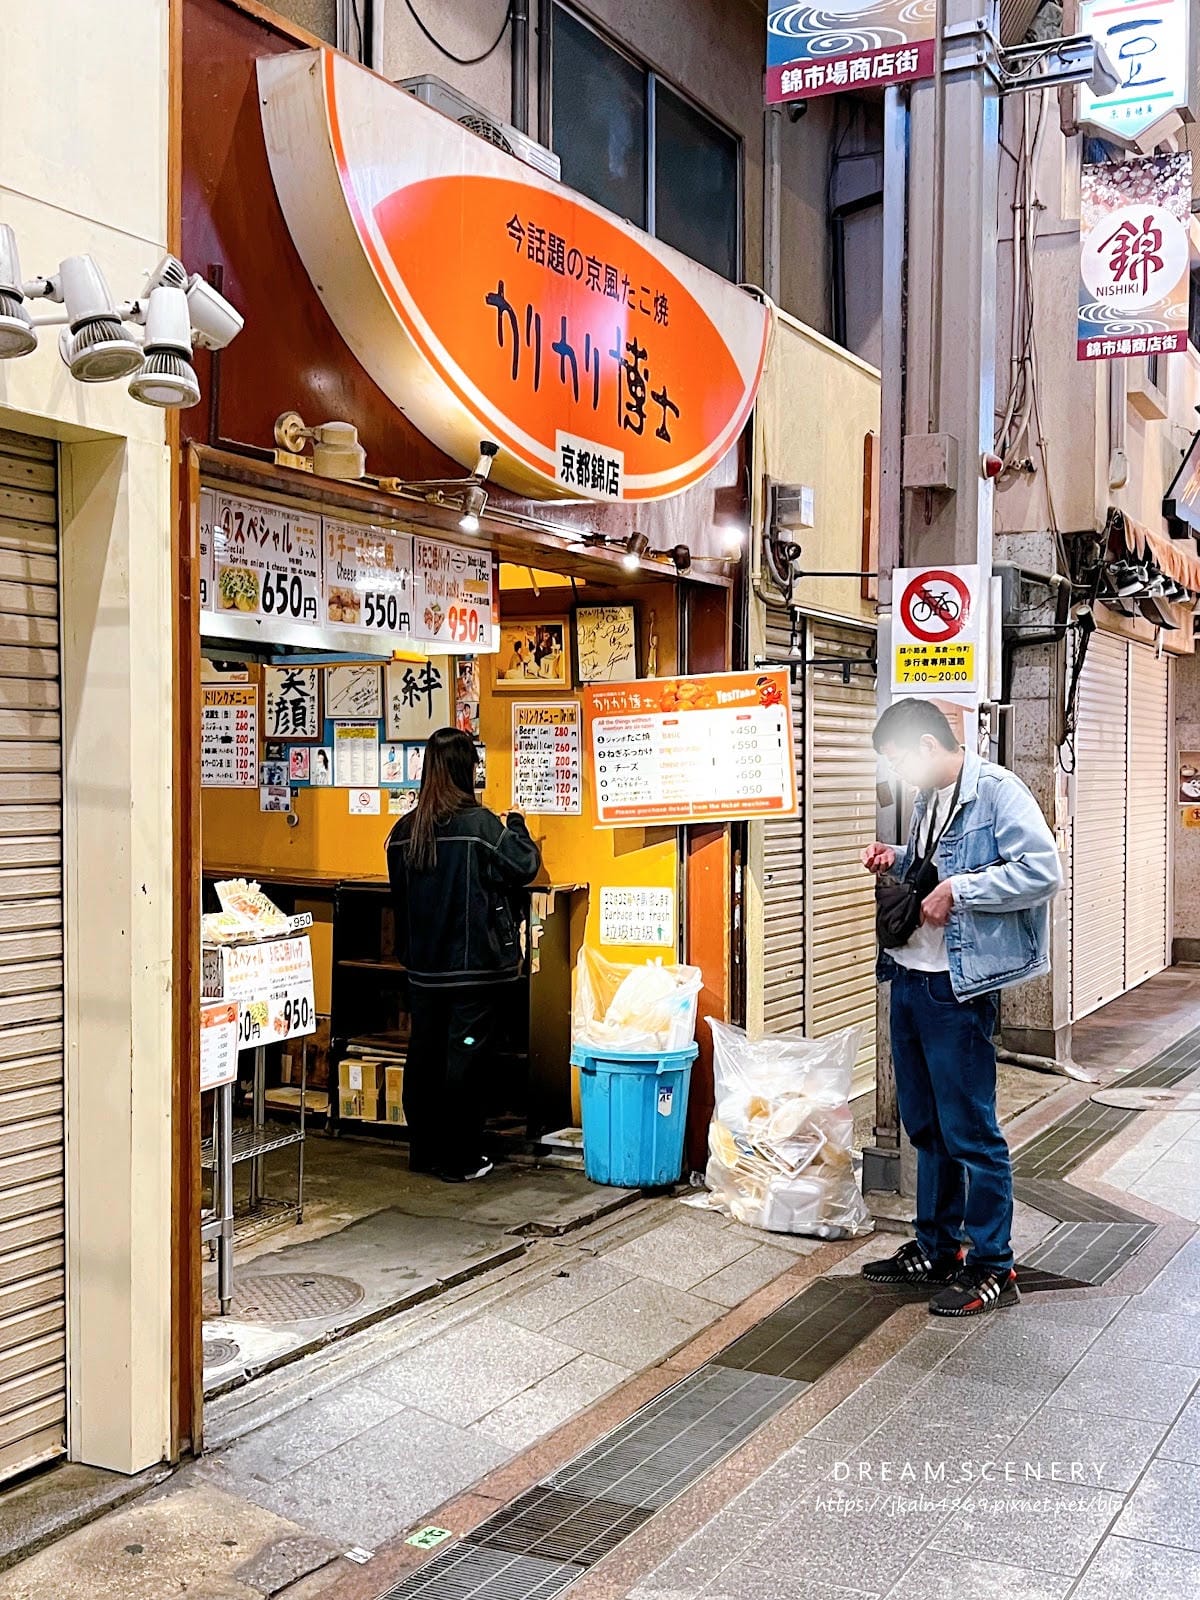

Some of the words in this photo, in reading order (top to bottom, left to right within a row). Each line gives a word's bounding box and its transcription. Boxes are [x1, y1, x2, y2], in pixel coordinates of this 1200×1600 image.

[781, 48, 919, 94] 錦市場商店街
[505, 213, 669, 327] 今話題の京風たこ焼
[1097, 215, 1164, 296] 錦
[1096, 284, 1139, 297] NISHIKI
[485, 279, 680, 443] カリカリ博士
[1086, 334, 1178, 357] 錦市場商店街
[560, 444, 619, 496] 京都錦店
[262, 571, 317, 619] 650円
[364, 591, 410, 631] 550円
[904, 657, 965, 667] 歩行者専用道路
[205, 690, 255, 705] ドリンクメニュー
[519, 725, 536, 735] Beer
[519, 755, 535, 765] Coke
[614, 762, 639, 772] チーズ
